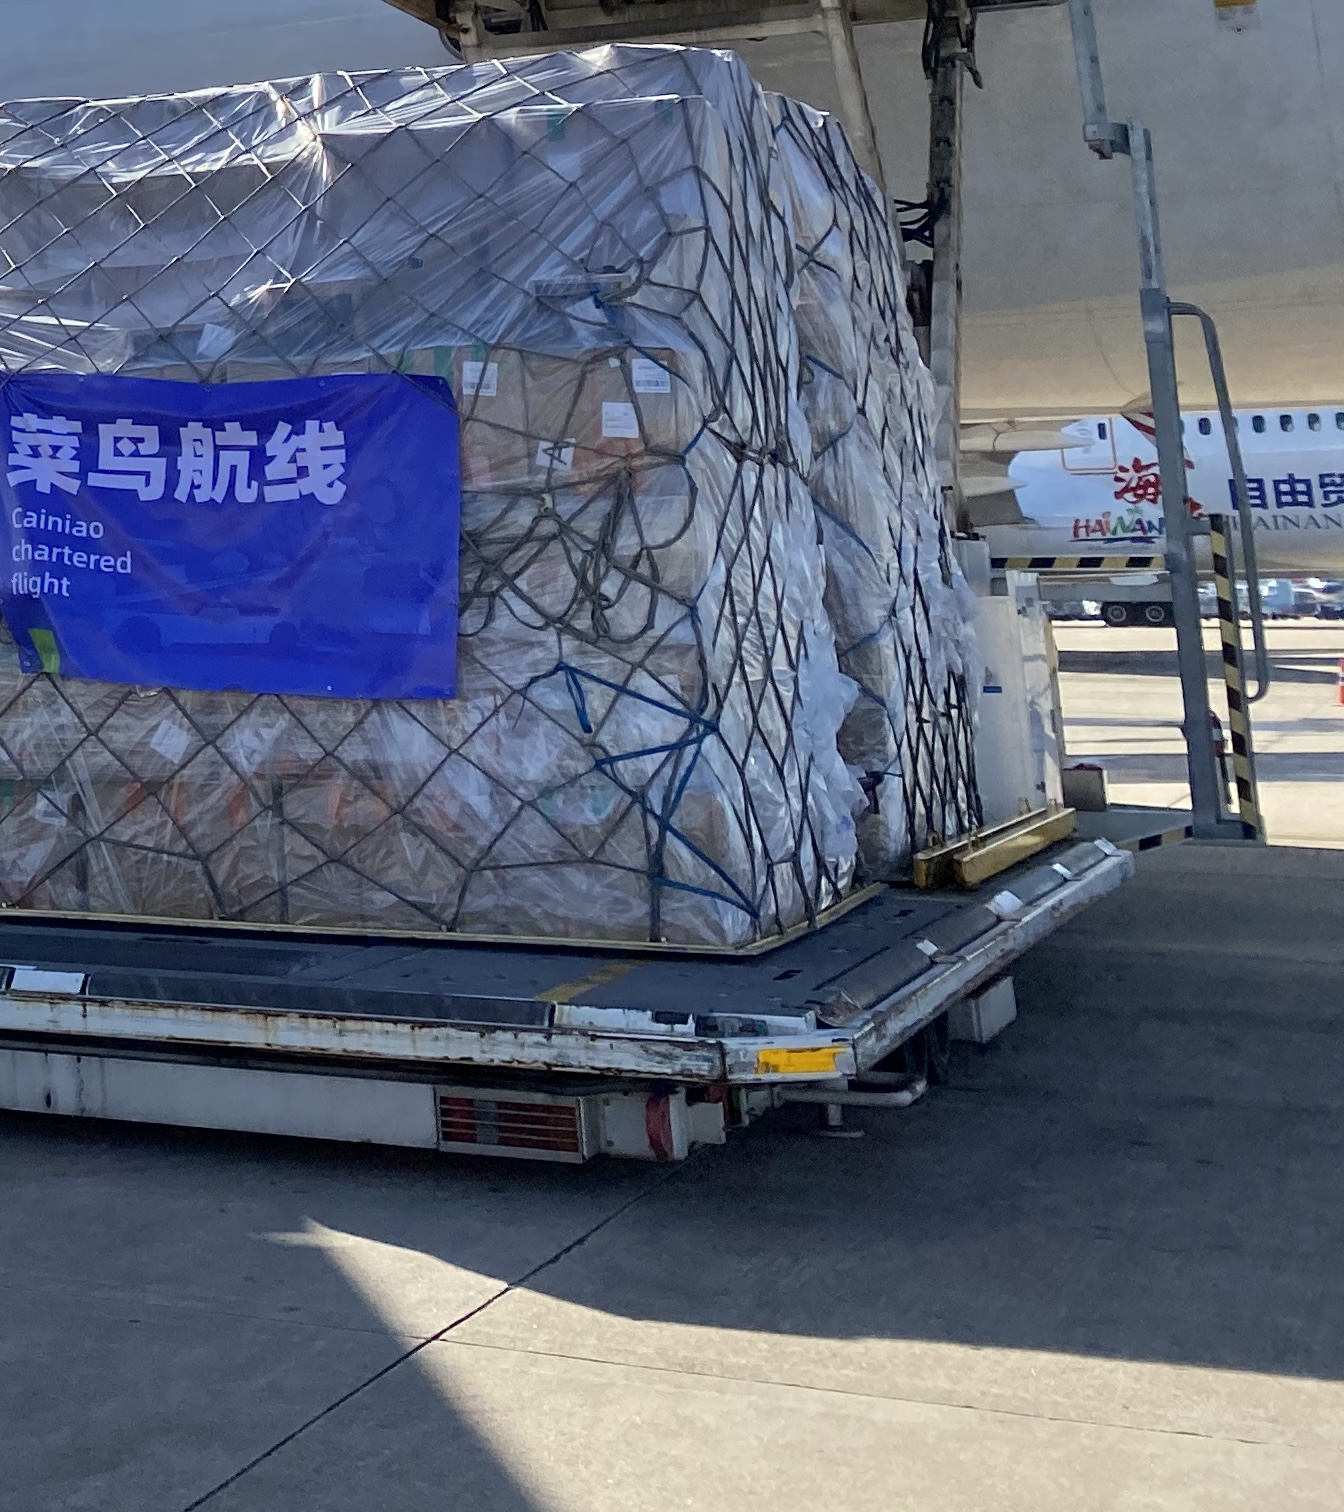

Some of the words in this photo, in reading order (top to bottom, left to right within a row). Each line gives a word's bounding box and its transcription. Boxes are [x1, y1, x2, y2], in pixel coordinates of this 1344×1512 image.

[6, 412, 348, 505] 菜鸟航线
[12, 507, 104, 539] Cainiao
[12, 538, 132, 574] chartered
[11, 571, 71, 599] flight
